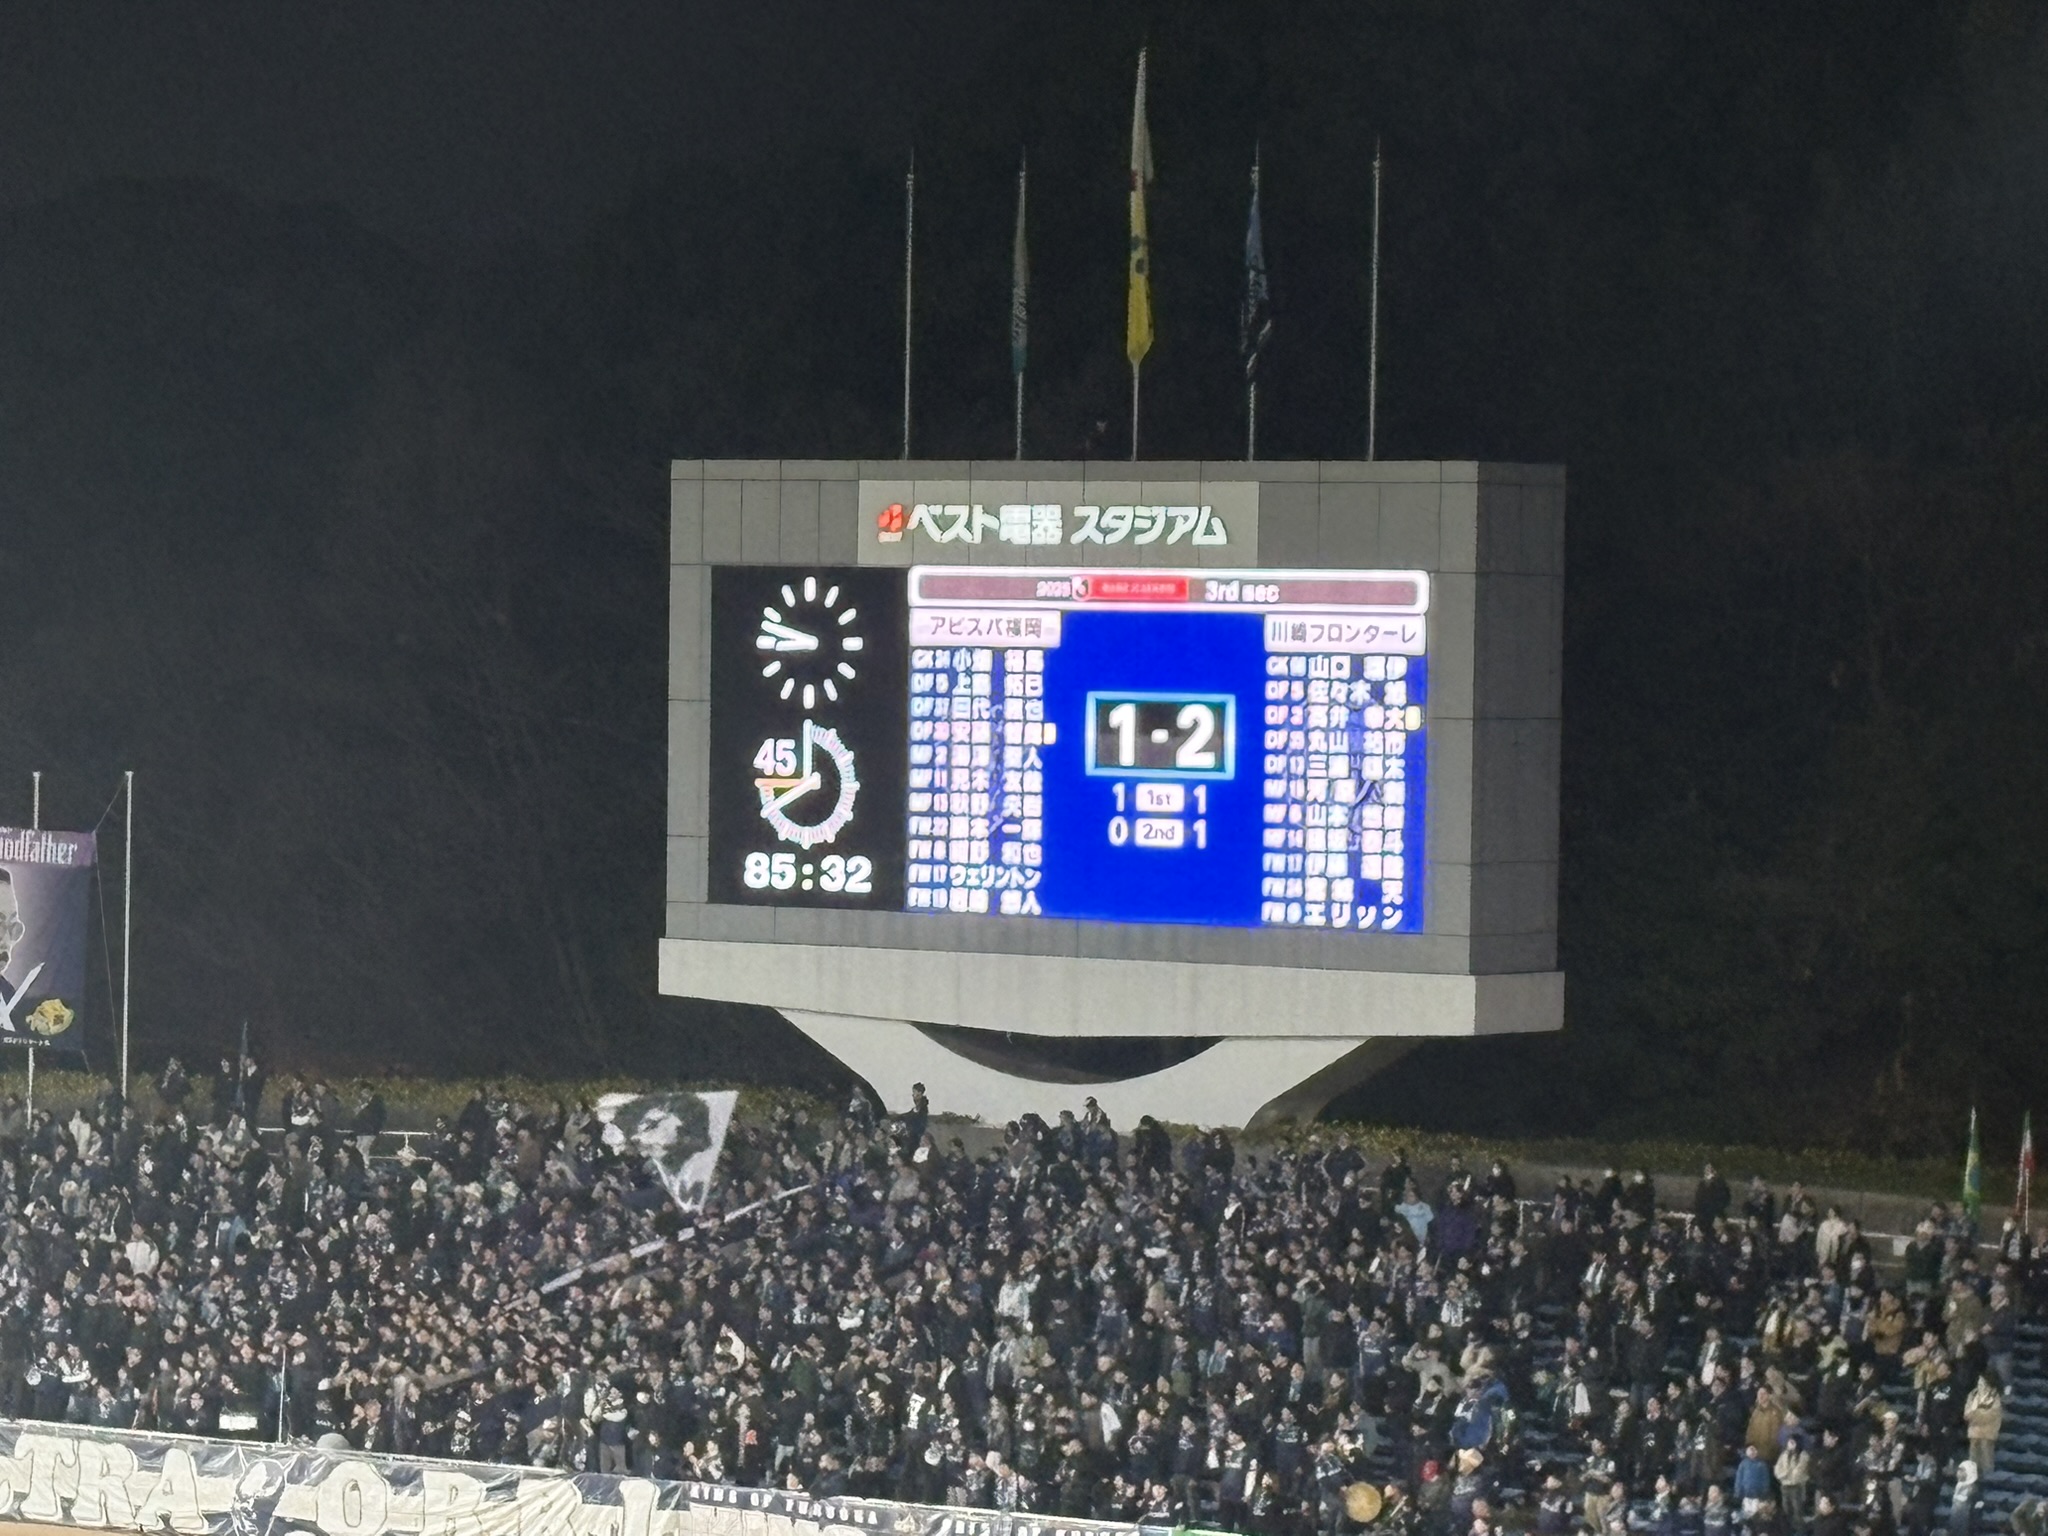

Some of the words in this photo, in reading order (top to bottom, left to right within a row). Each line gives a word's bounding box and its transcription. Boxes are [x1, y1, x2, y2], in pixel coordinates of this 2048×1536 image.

[907, 504, 1062, 544] ベスト電器
[1070, 505, 1227, 545] スタジアム
[1108, 703, 1136, 766] 1
[1175, 704, 1216, 768] 2
[753, 738, 797, 777] 45
[1112, 782, 1125, 812] 1
[1147, 790, 1171, 806] 1st
[1193, 784, 1207, 815] 1
[1107, 815, 1129, 847] 0
[1142, 823, 1176, 841] 2nd
[1193, 818, 1207, 849] 1
[743, 852, 873, 894] 85:32
